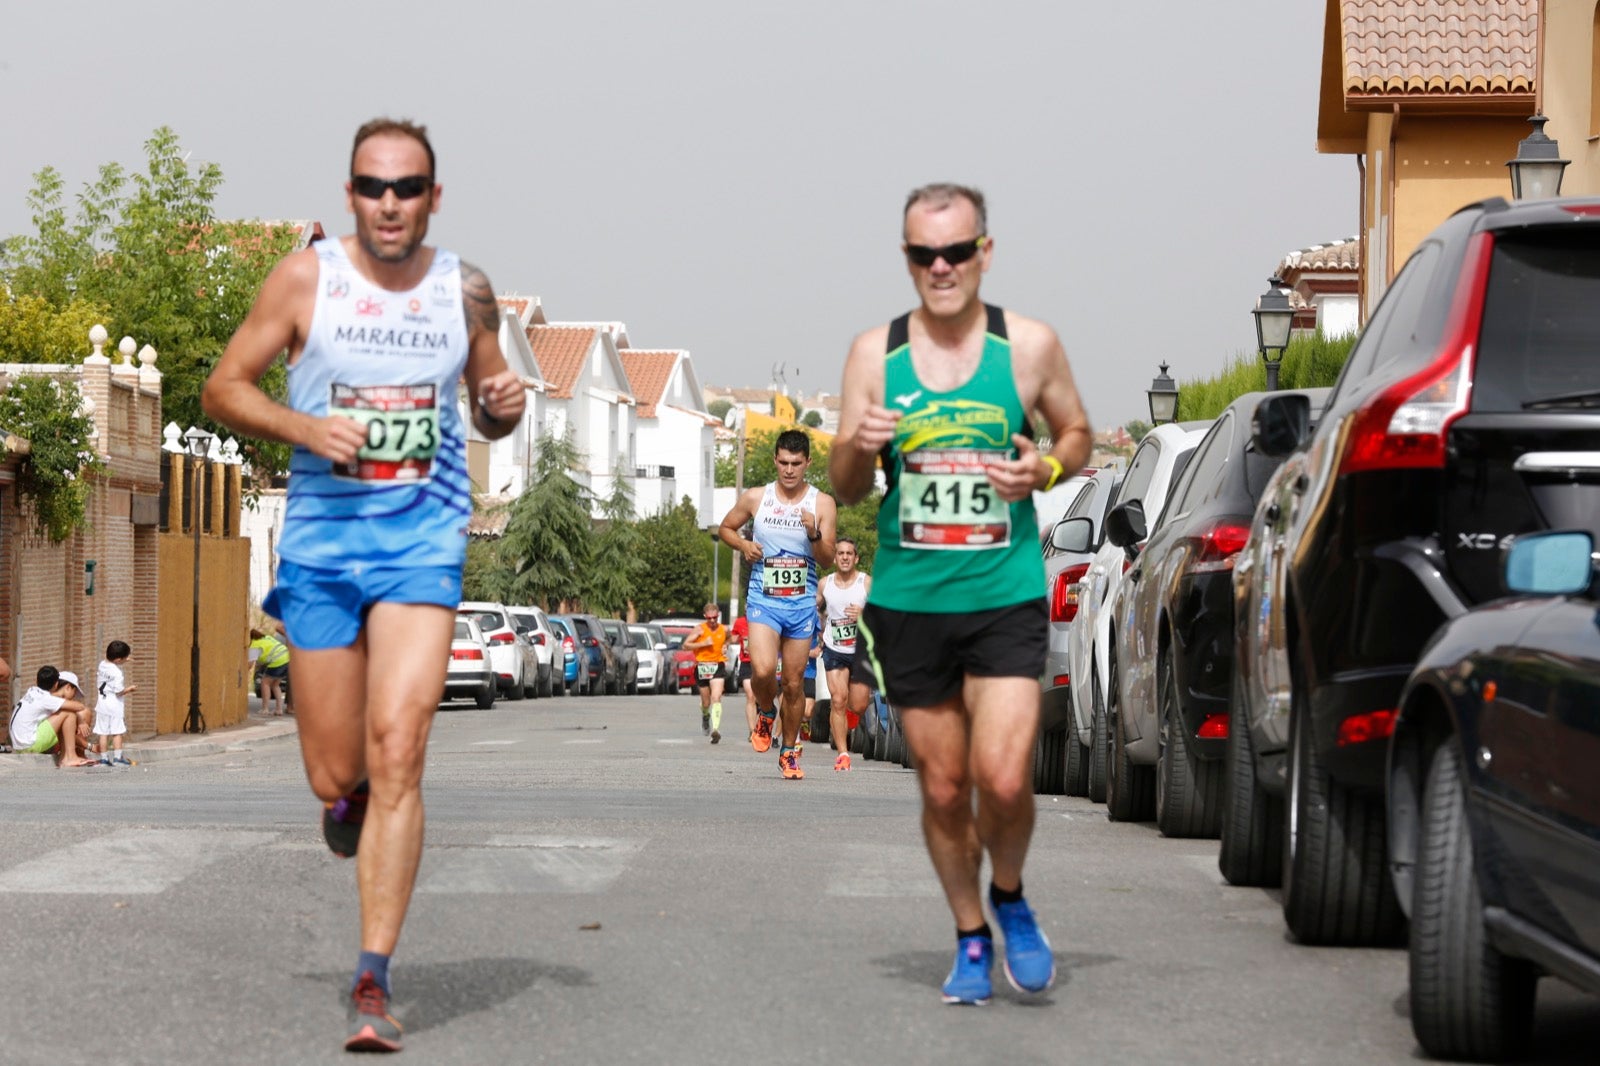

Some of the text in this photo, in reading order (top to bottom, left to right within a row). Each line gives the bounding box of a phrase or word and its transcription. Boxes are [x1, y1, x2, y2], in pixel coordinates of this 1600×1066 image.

[334, 325, 449, 349] MARACENA
[350, 415, 436, 451] 073
[920, 481, 991, 515] 415
[763, 517, 806, 528] MARACEN
[772, 569, 802, 585] 193
